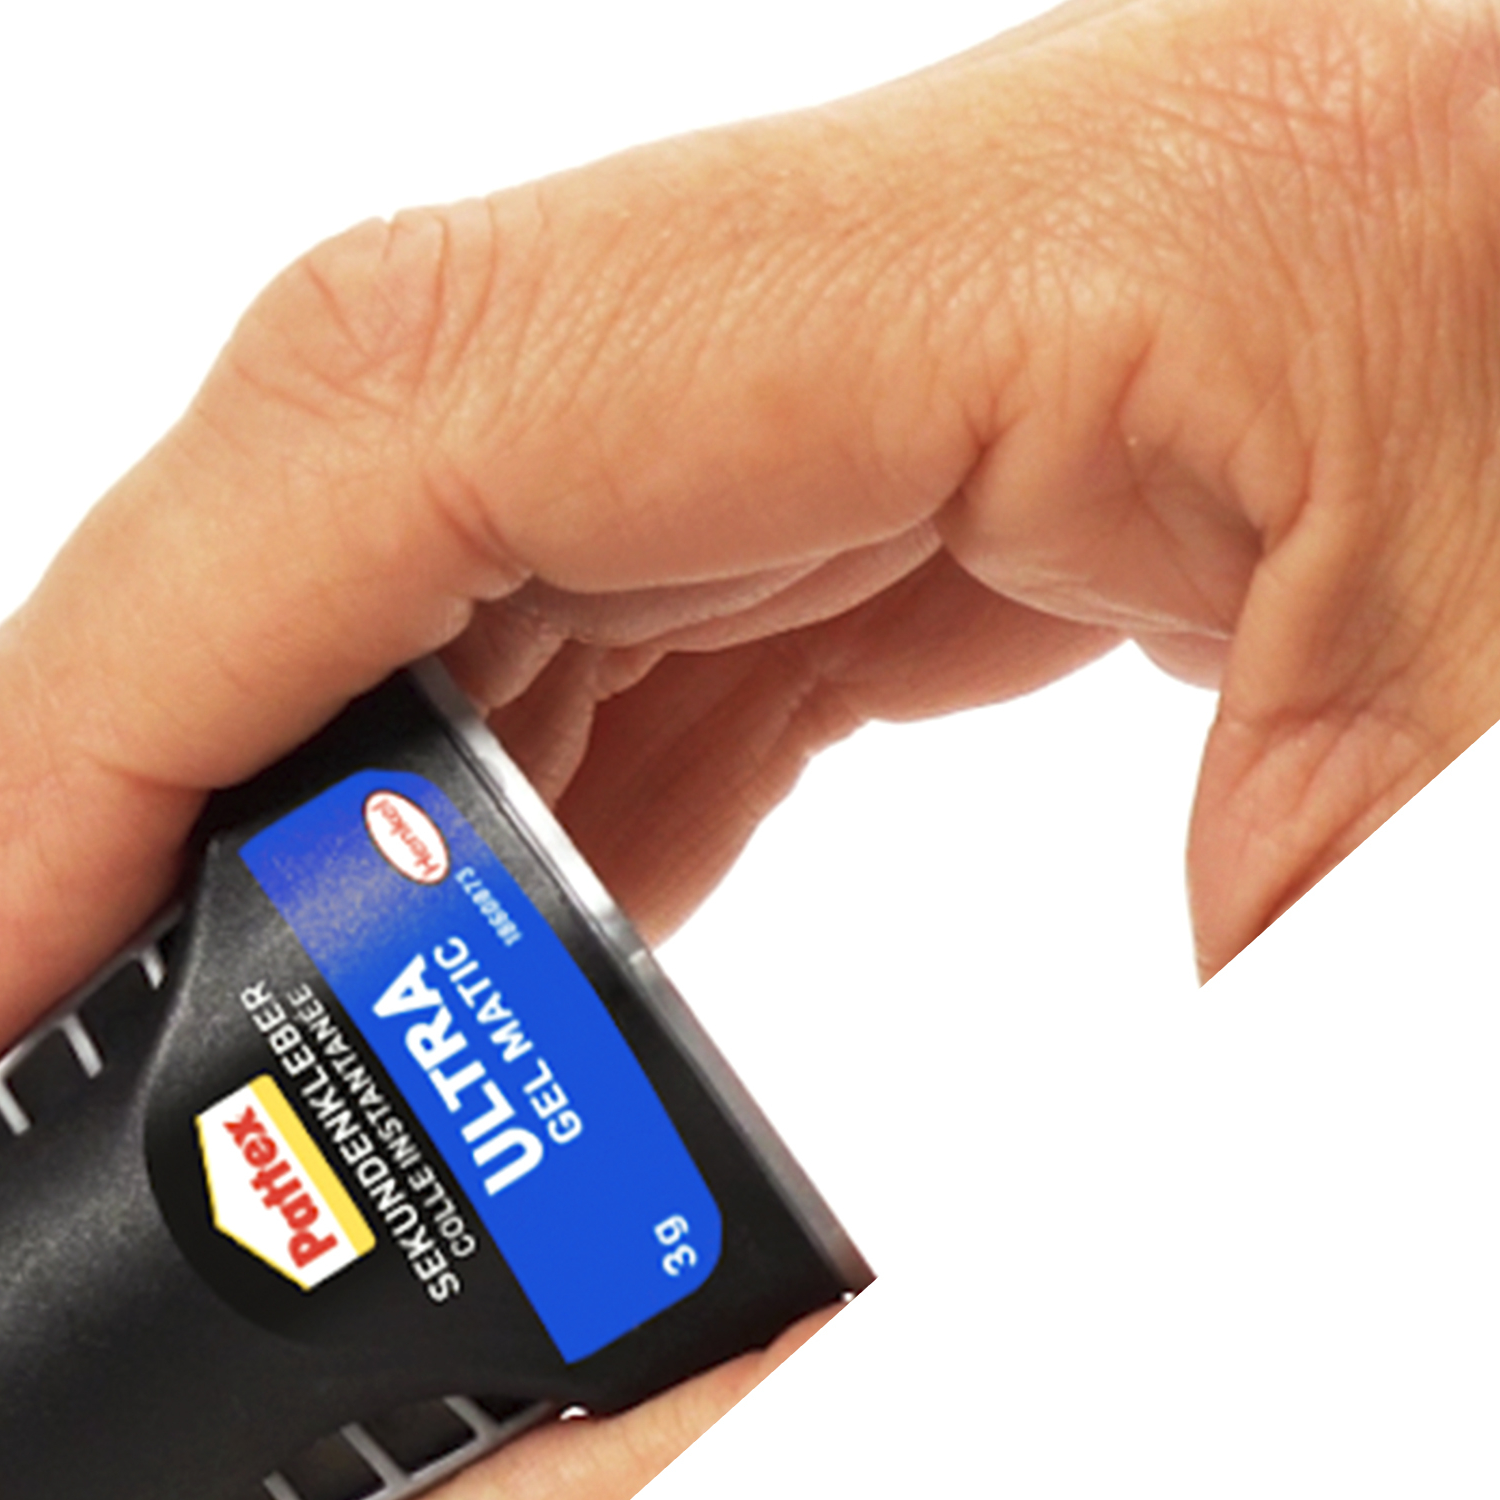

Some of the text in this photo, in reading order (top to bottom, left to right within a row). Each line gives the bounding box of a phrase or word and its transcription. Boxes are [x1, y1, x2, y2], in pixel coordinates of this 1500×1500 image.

[371, 799, 440, 878] Henkel
[239, 979, 461, 1302] SEKUNDENKLEBER
[287, 982, 476, 1258] COLLE INSTANTANÉE
[372, 953, 544, 1197] ULTRA
[433, 937, 583, 1145] GEL MATIC
[223, 1106, 338, 1269] Pattex
[654, 1214, 697, 1276] 3g
